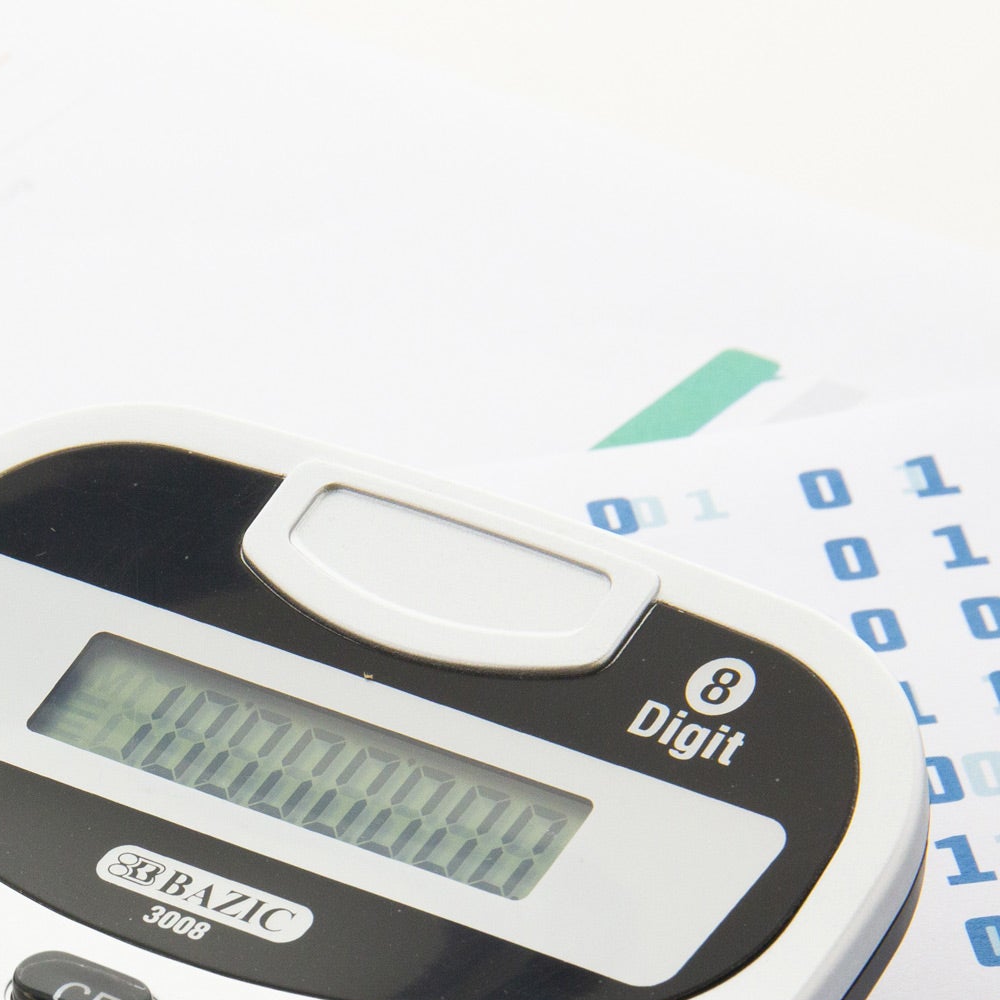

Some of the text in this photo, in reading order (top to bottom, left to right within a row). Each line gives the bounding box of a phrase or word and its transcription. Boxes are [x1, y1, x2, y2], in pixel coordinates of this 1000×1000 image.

[798, 468, 852, 510] 0
[904, 455, 961, 498] 1
[586, 497, 639, 535] 0
[823, 537, 879, 581] 0
[931, 525, 989, 569] 1
[851, 608, 907, 652] 0
[700, 667, 741, 705] 8
[627, 699, 745, 767] Digit
[934, 834, 998, 886] 1
[142, 905, 211, 940] 3008
[158, 869, 296, 933] BAZIC
